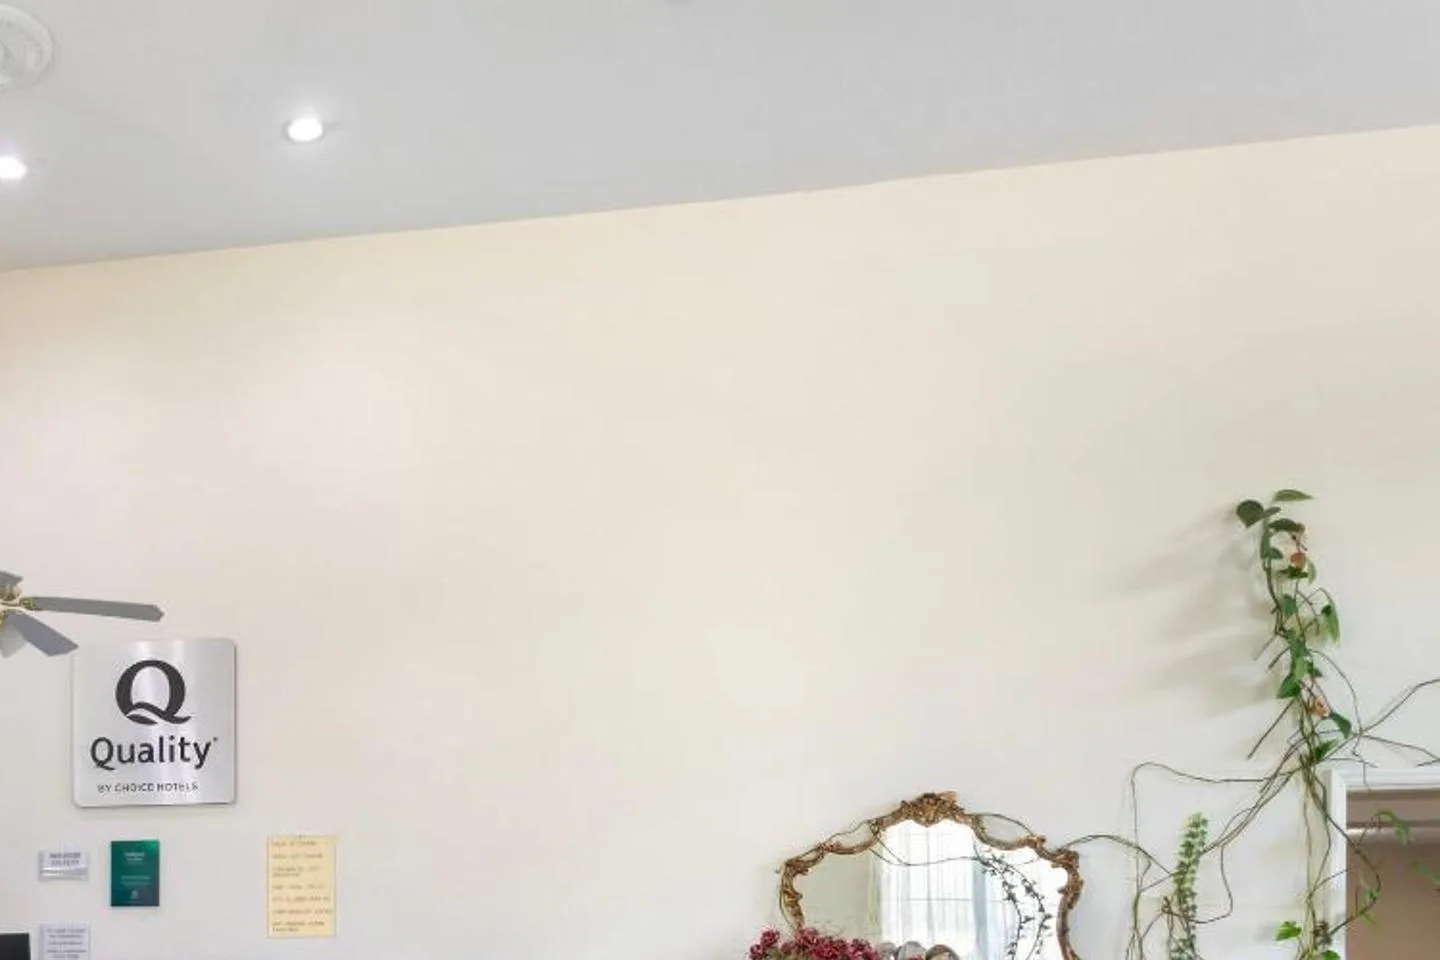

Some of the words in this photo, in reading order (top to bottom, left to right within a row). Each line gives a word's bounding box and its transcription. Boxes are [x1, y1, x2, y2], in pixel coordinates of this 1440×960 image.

[115, 659, 192, 726] Q
[90, 735, 212, 770] Quality
[97, 782, 112, 794] BY
[114, 782, 155, 793] CHOICE
[156, 781, 200, 793] HOTELS
